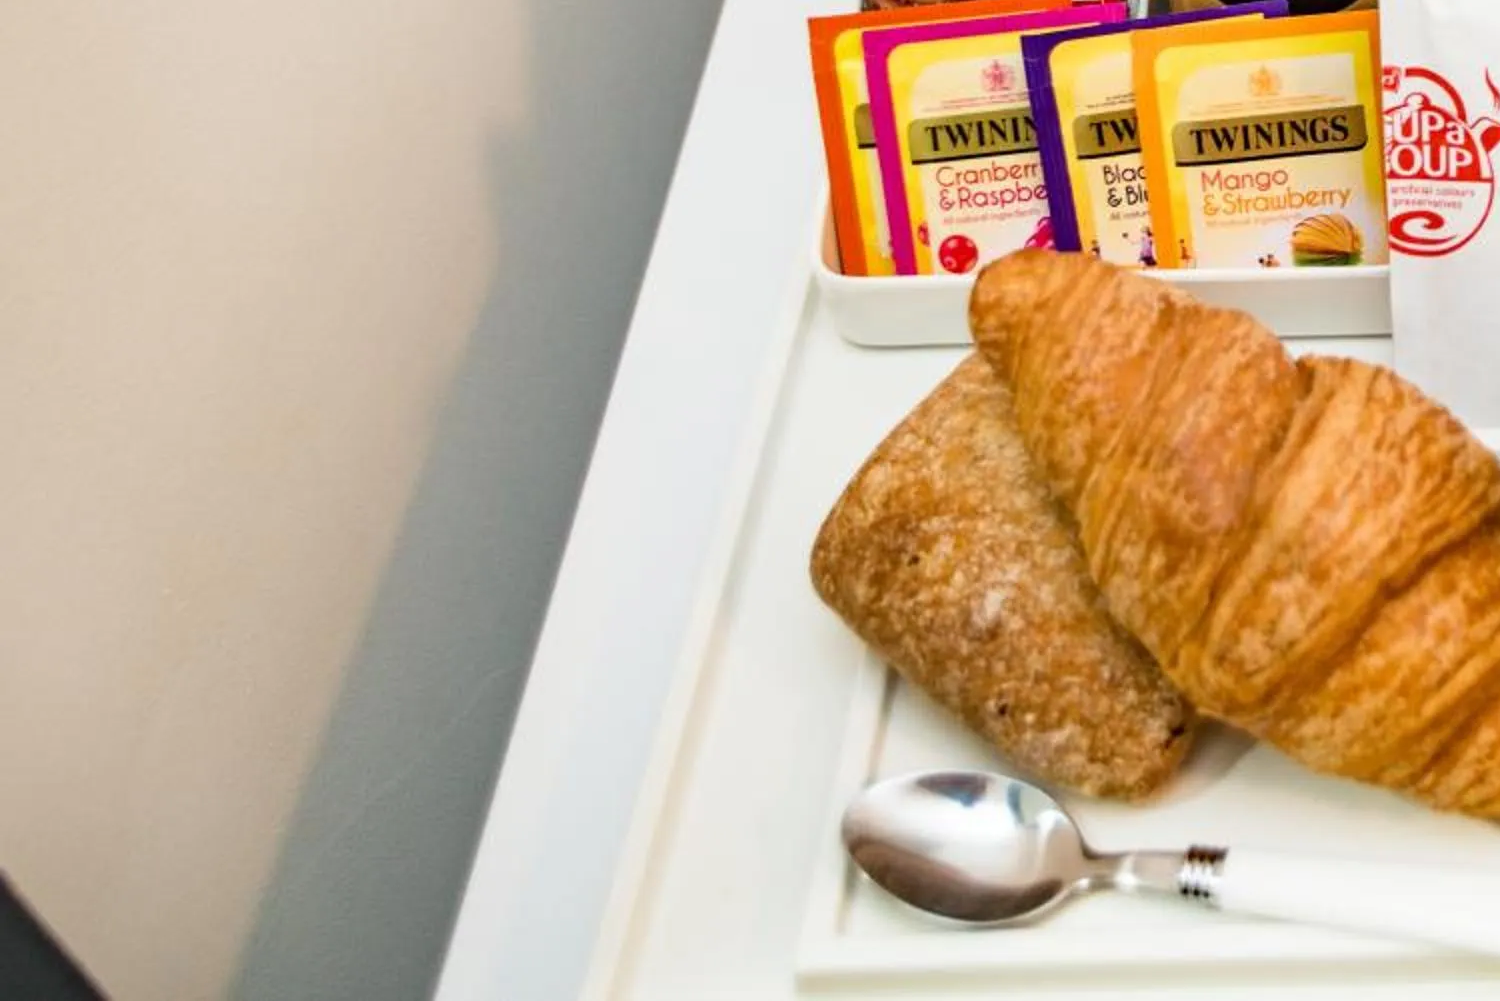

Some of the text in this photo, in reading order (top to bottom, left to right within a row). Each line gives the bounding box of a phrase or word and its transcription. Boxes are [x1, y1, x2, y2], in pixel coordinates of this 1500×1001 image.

[924, 115, 1038, 152] TWININ
[1089, 117, 1138, 148] TW
[1190, 114, 1349, 156] TWININGS
[936, 161, 1039, 187] Cranberr
[1102, 164, 1147, 186] Blac
[1201, 169, 1289, 192] Mango
[958, 181, 1048, 209] Raspbe
